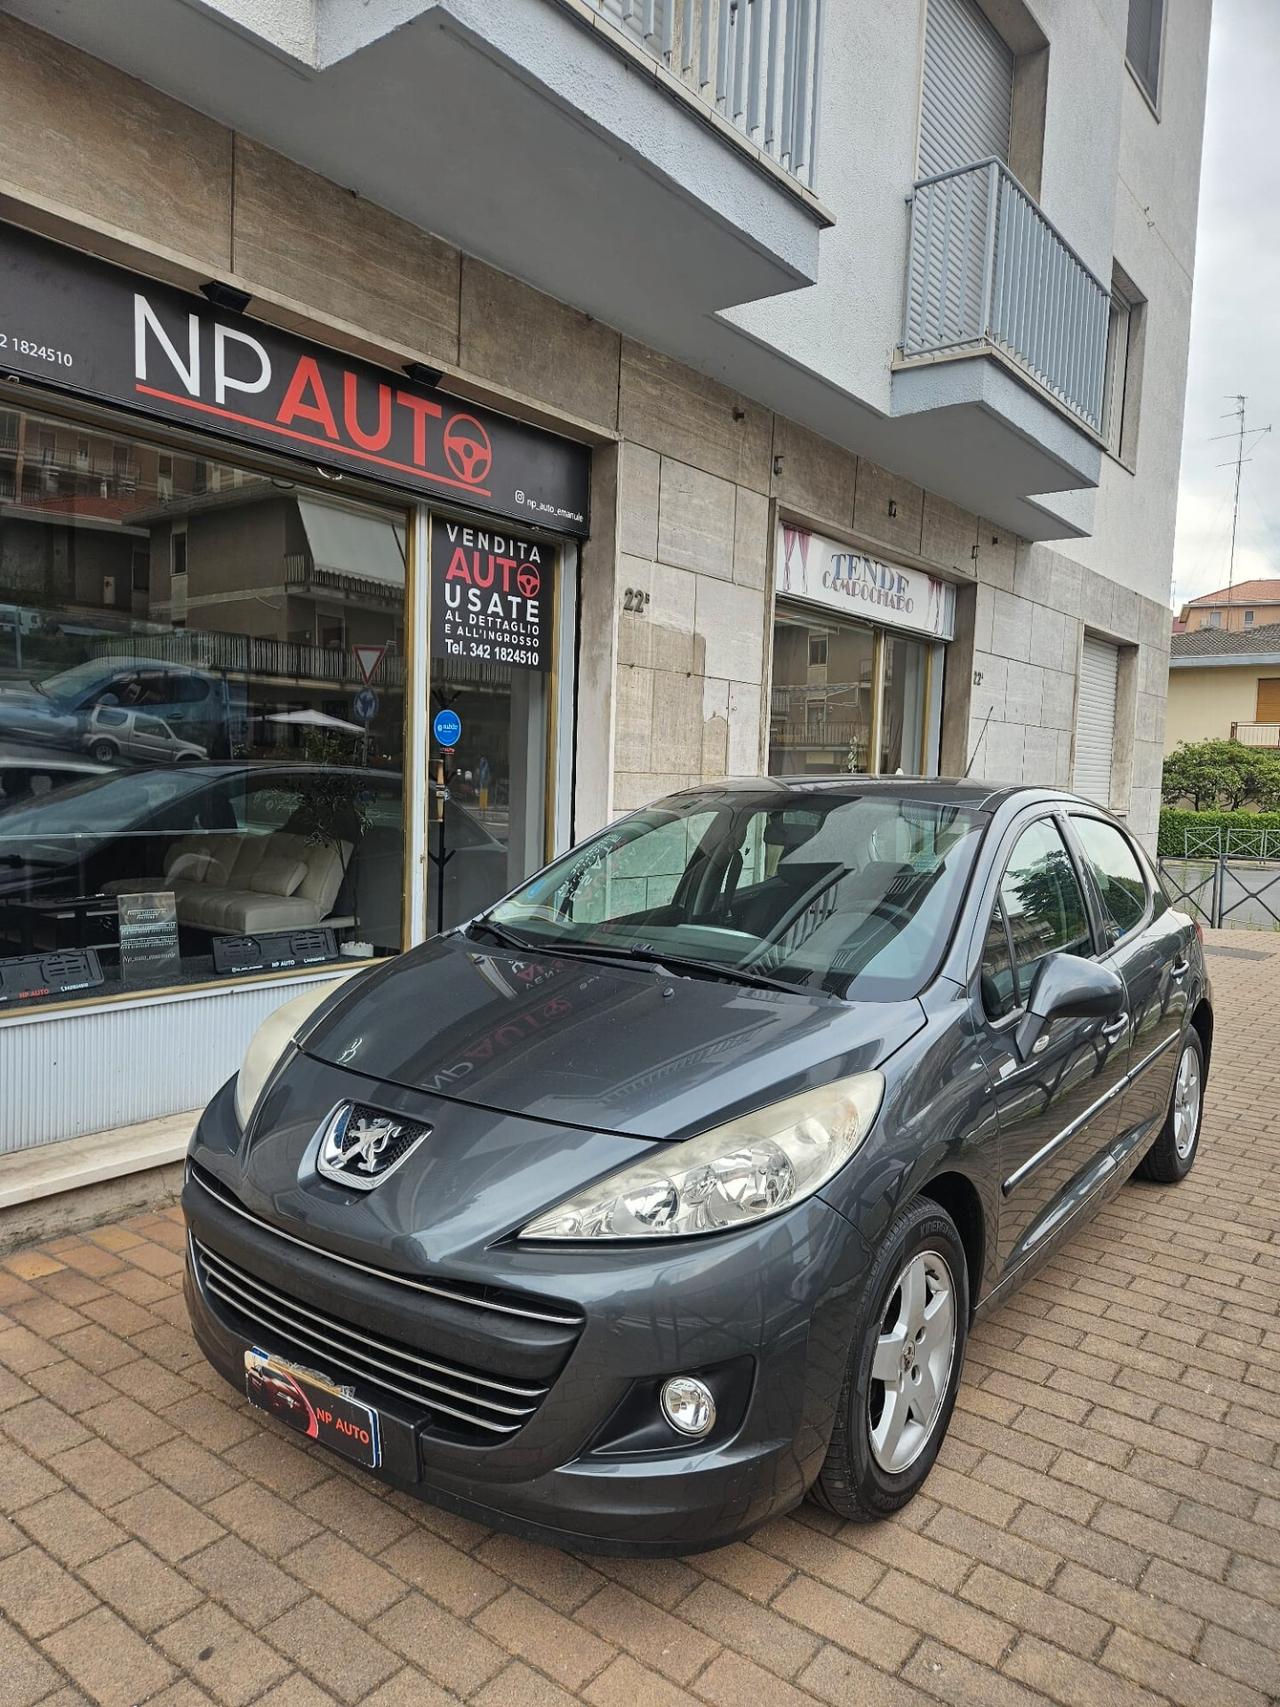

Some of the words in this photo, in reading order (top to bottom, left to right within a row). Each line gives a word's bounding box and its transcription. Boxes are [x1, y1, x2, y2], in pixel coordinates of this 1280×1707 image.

[12, 337, 73, 367] 1824510
[446, 523, 541, 564] VENDITA
[830, 553, 910, 595] TENDE
[444, 582, 540, 623] USATE
[445, 609, 463, 622] AL
[469, 613, 540, 636] DETTAGLIO
[445, 624, 452, 634] E
[457, 625, 540, 648] ALL'INGROSSO
[445, 639, 467, 656] Tel.
[470, 642, 491, 659] 342
[494, 647, 540, 666] 1824510
[316, 1408, 333, 1424] NP
[335, 1418, 370, 1445] AUTO
